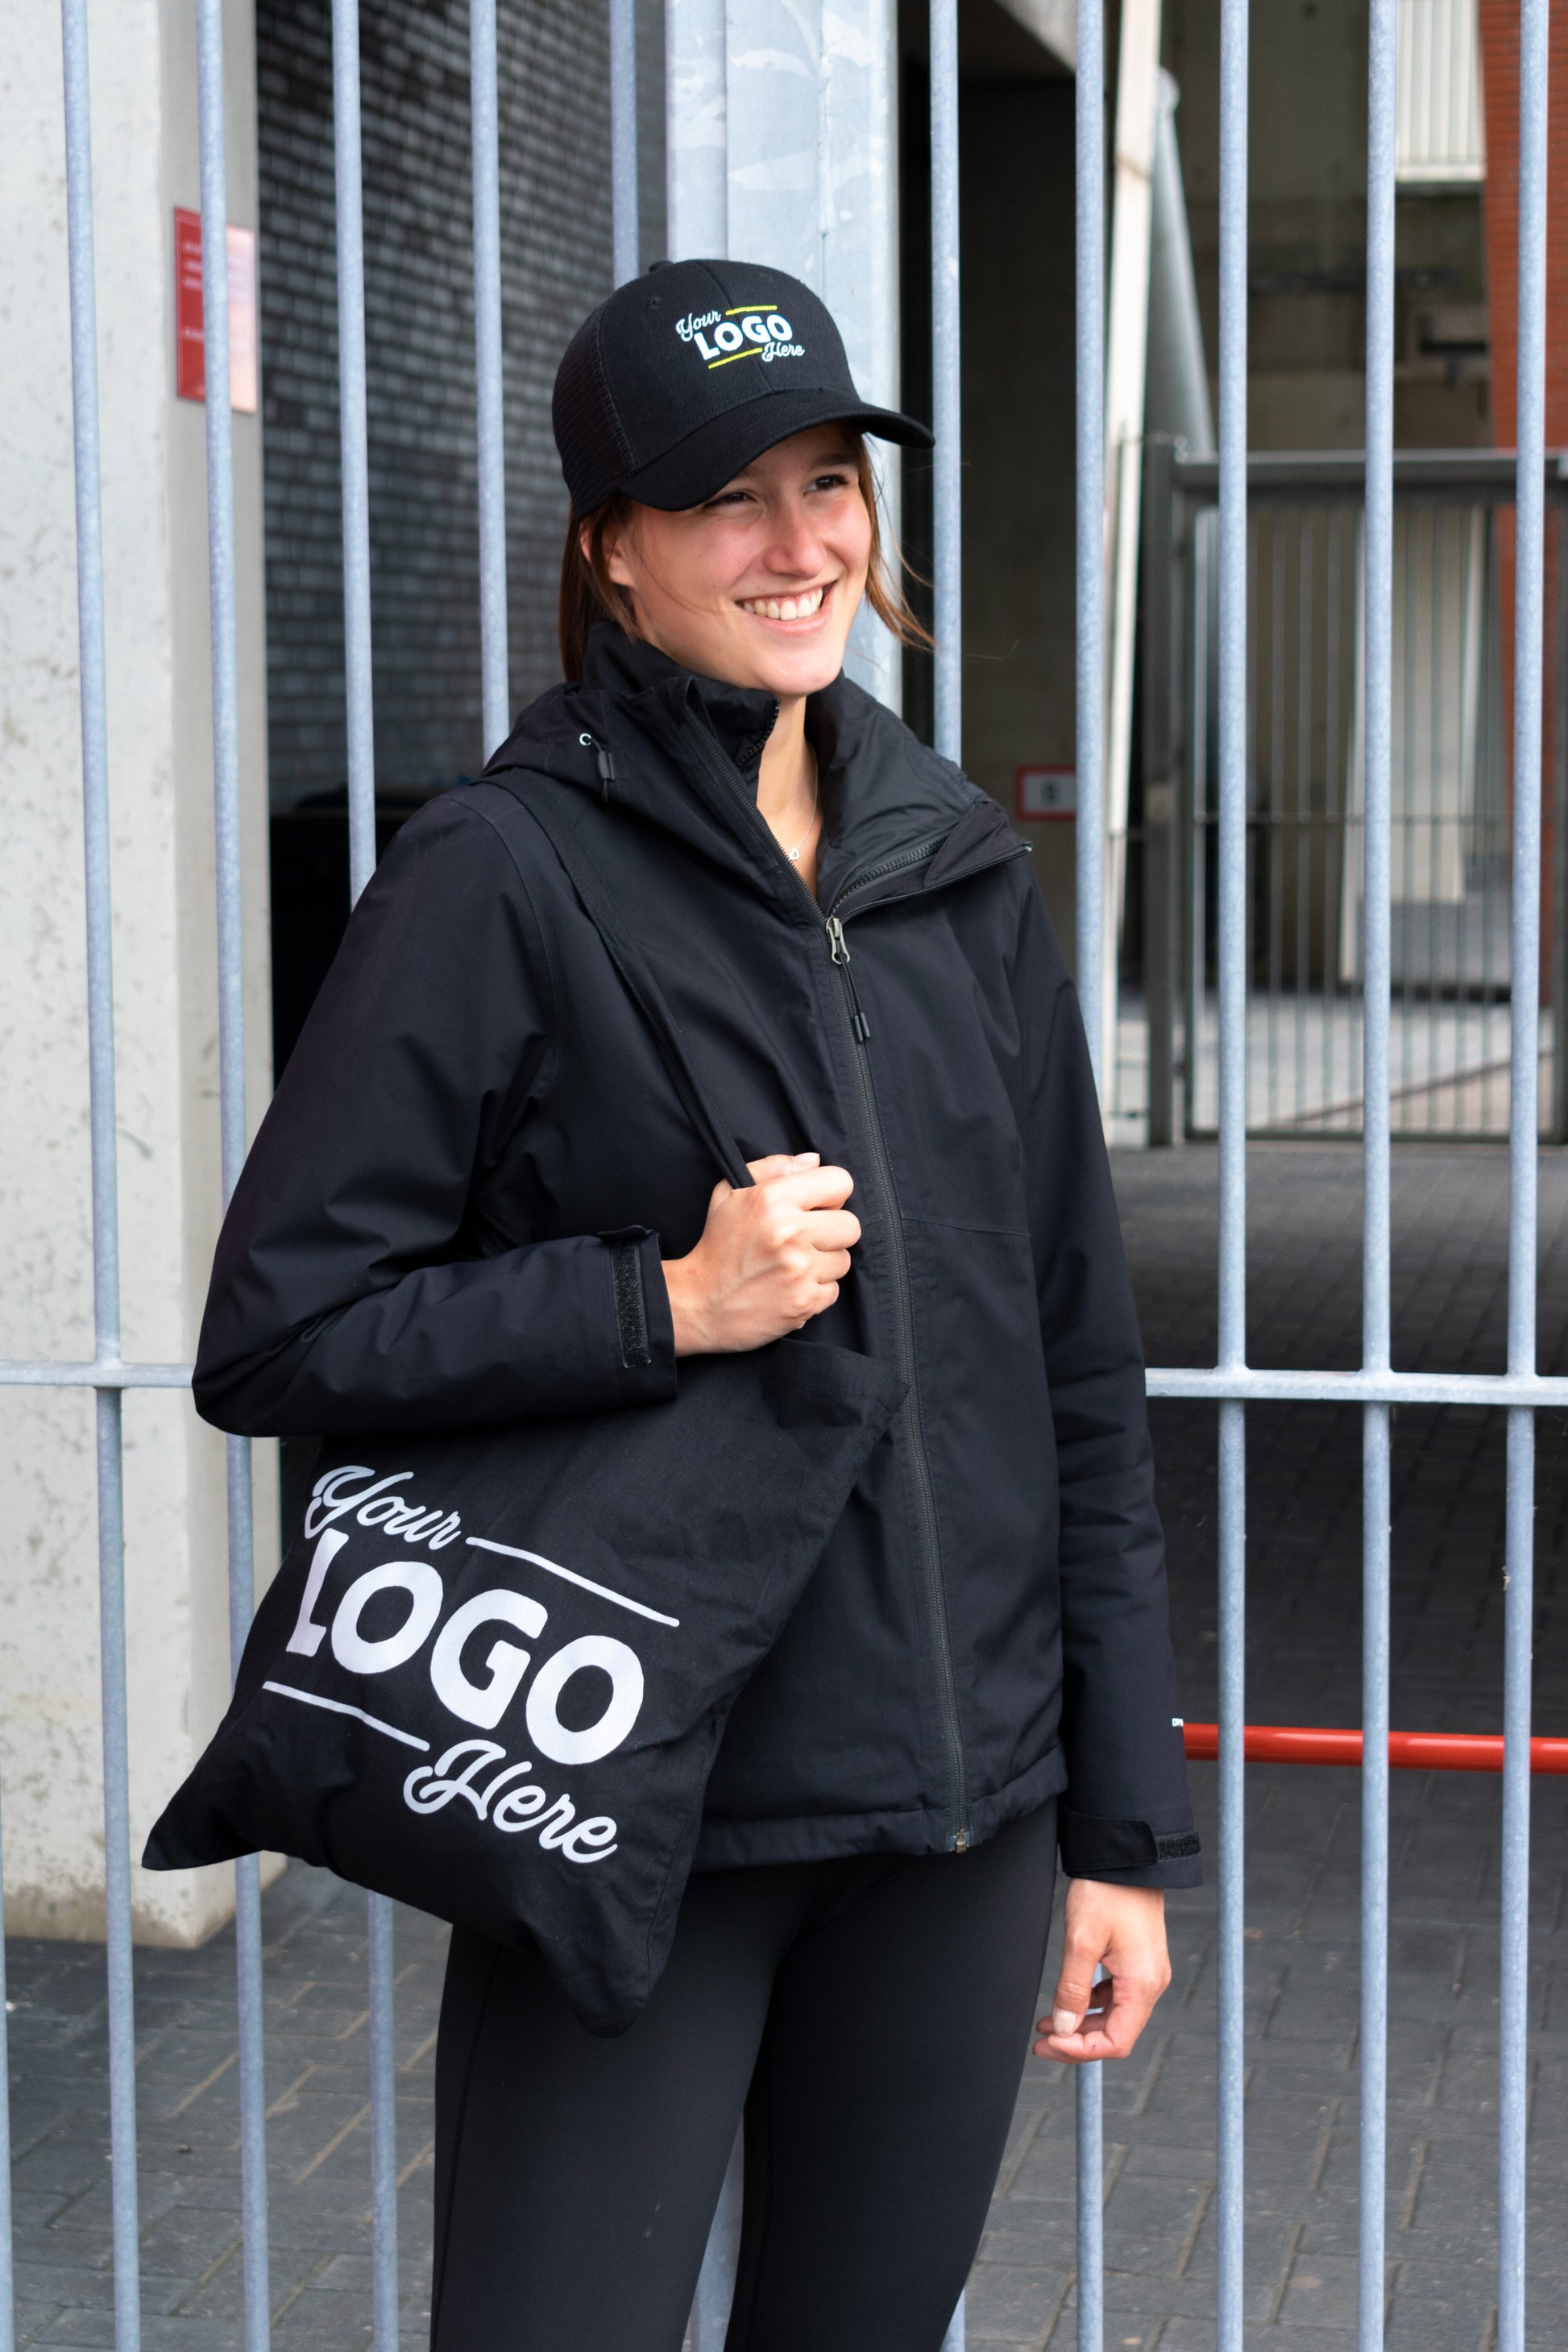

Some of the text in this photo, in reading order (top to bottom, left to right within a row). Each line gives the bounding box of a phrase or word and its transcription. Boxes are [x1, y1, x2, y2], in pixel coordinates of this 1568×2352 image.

[675, 309, 721, 342] Your
[694, 314, 793, 361] LOGO
[761, 342, 805, 362] Here
[305, 1466, 461, 1549] Your
[286, 1528, 644, 1765] LOGO
[404, 1739, 617, 1863] Here
